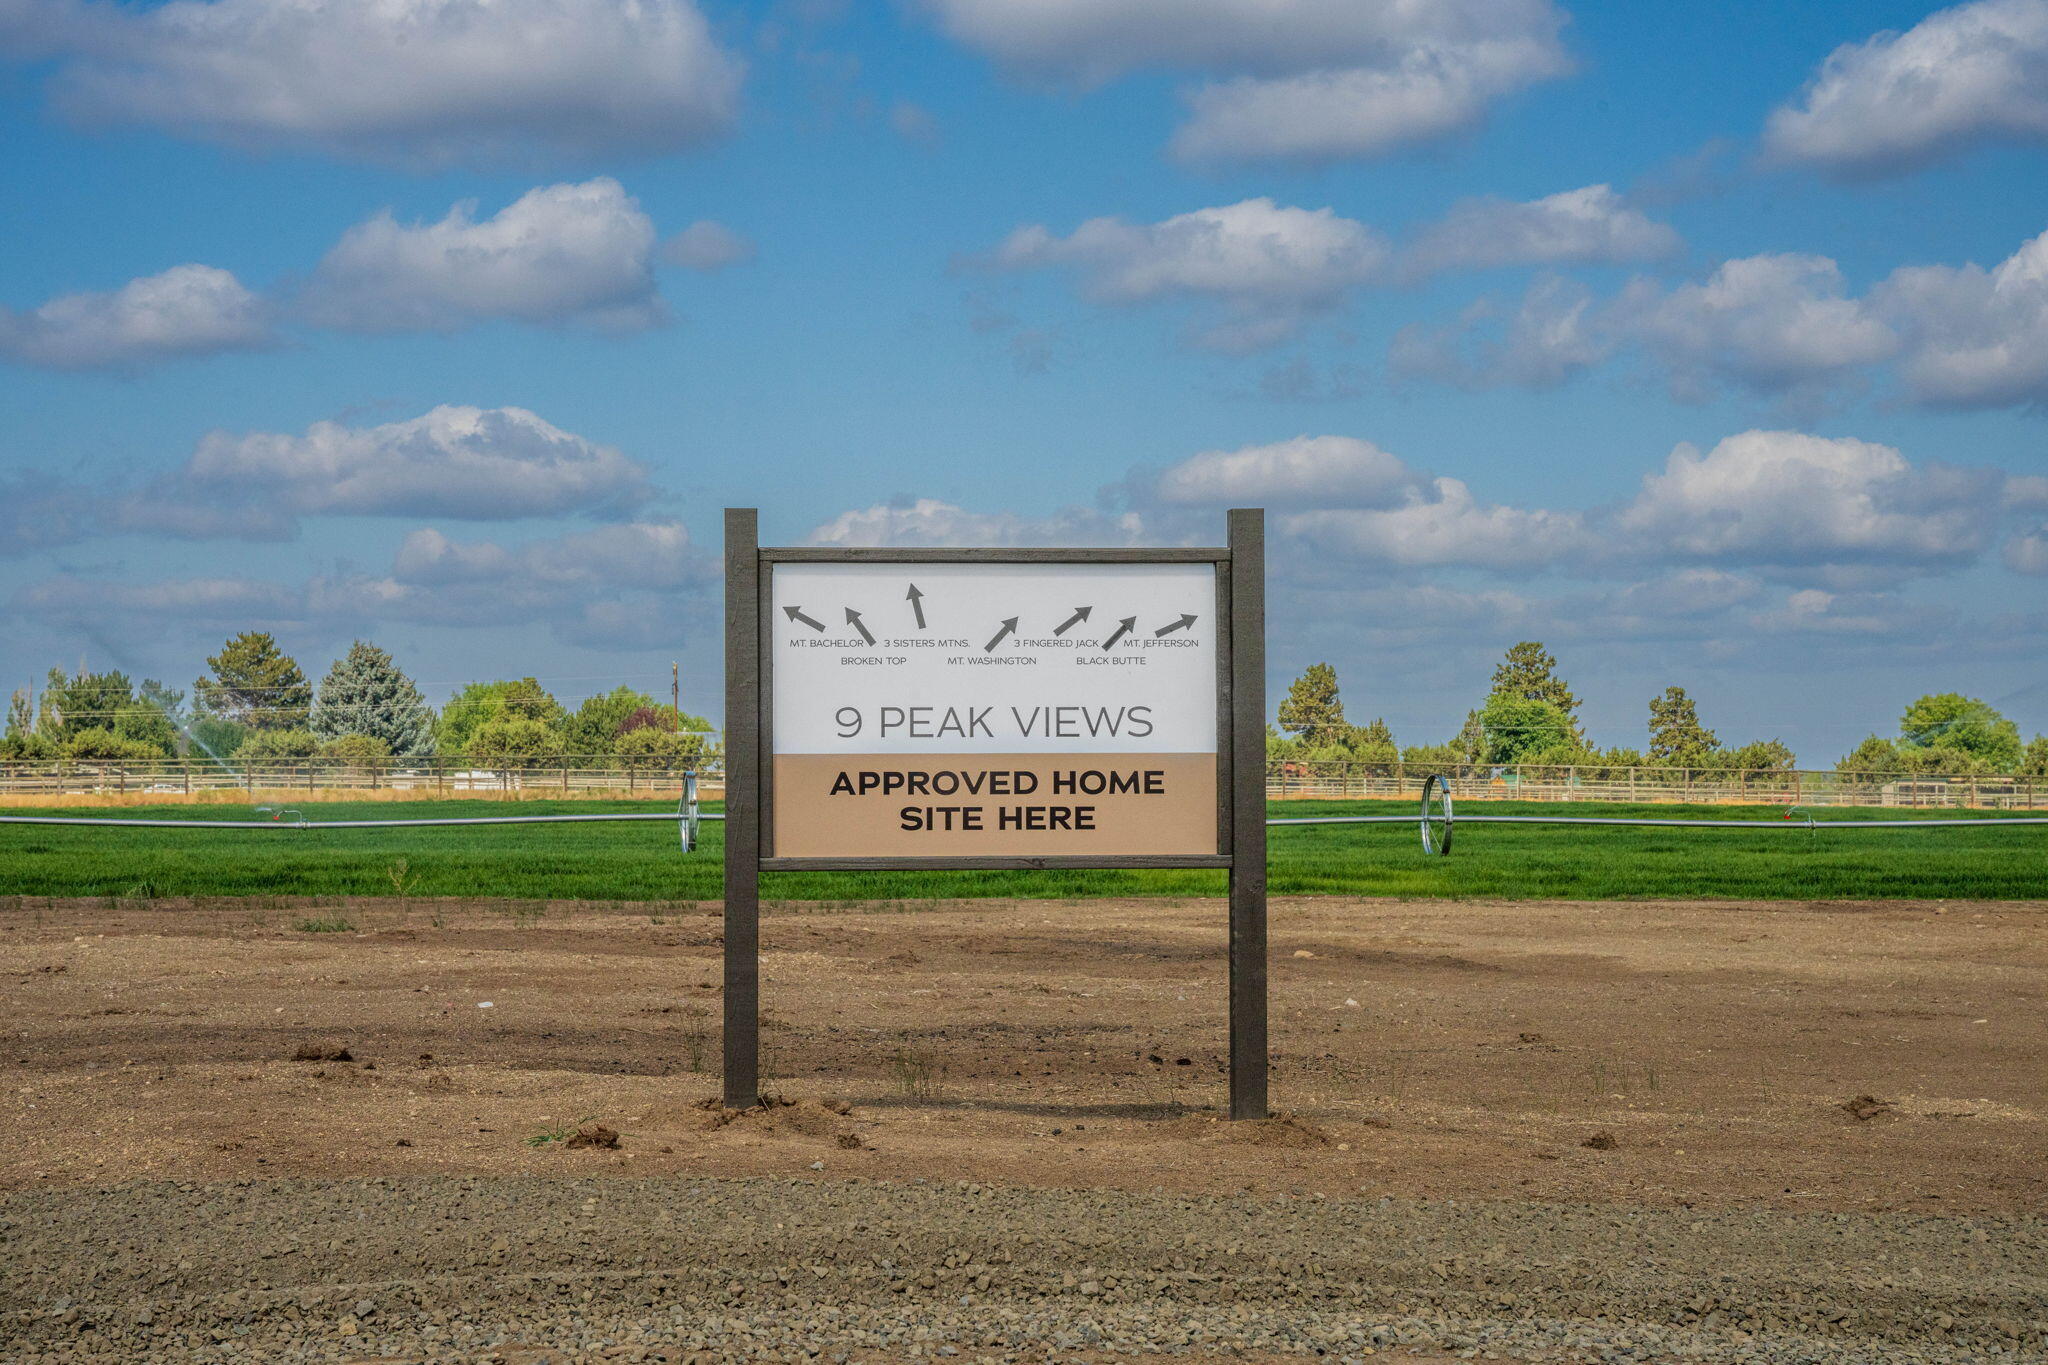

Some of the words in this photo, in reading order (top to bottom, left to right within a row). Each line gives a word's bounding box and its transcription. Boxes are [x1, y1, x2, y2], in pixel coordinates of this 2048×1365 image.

[789, 639, 807, 648] MT.
[810, 639, 864, 648] BACHELOR
[884, 639, 891, 648] 3
[893, 639, 935, 648] SISTERS
[938, 639, 970, 648] MTNS.
[1014, 639, 1021, 648] 3
[1023, 639, 1073, 648] FINGERED
[1075, 639, 1099, 648] JACK
[1123, 639, 1141, 648] MT.
[1142, 639, 1199, 648] JEFFERSON
[841, 656, 883, 665] BROKEN
[886, 656, 907, 665] TOP
[947, 656, 965, 665] MT.
[967, 656, 1037, 665] WASHINGTON
[1076, 656, 1109, 665] BLACK
[1112, 656, 1146, 665] BUTTE
[836, 707, 863, 738] 9
[881, 707, 995, 738] PEAK
[1011, 706, 1154, 738] VIEWS
[830, 770, 1038, 795] APPROVED
[1053, 770, 1164, 795] HOME
[900, 806, 983, 831] SITE
[999, 806, 1095, 831] HERE
